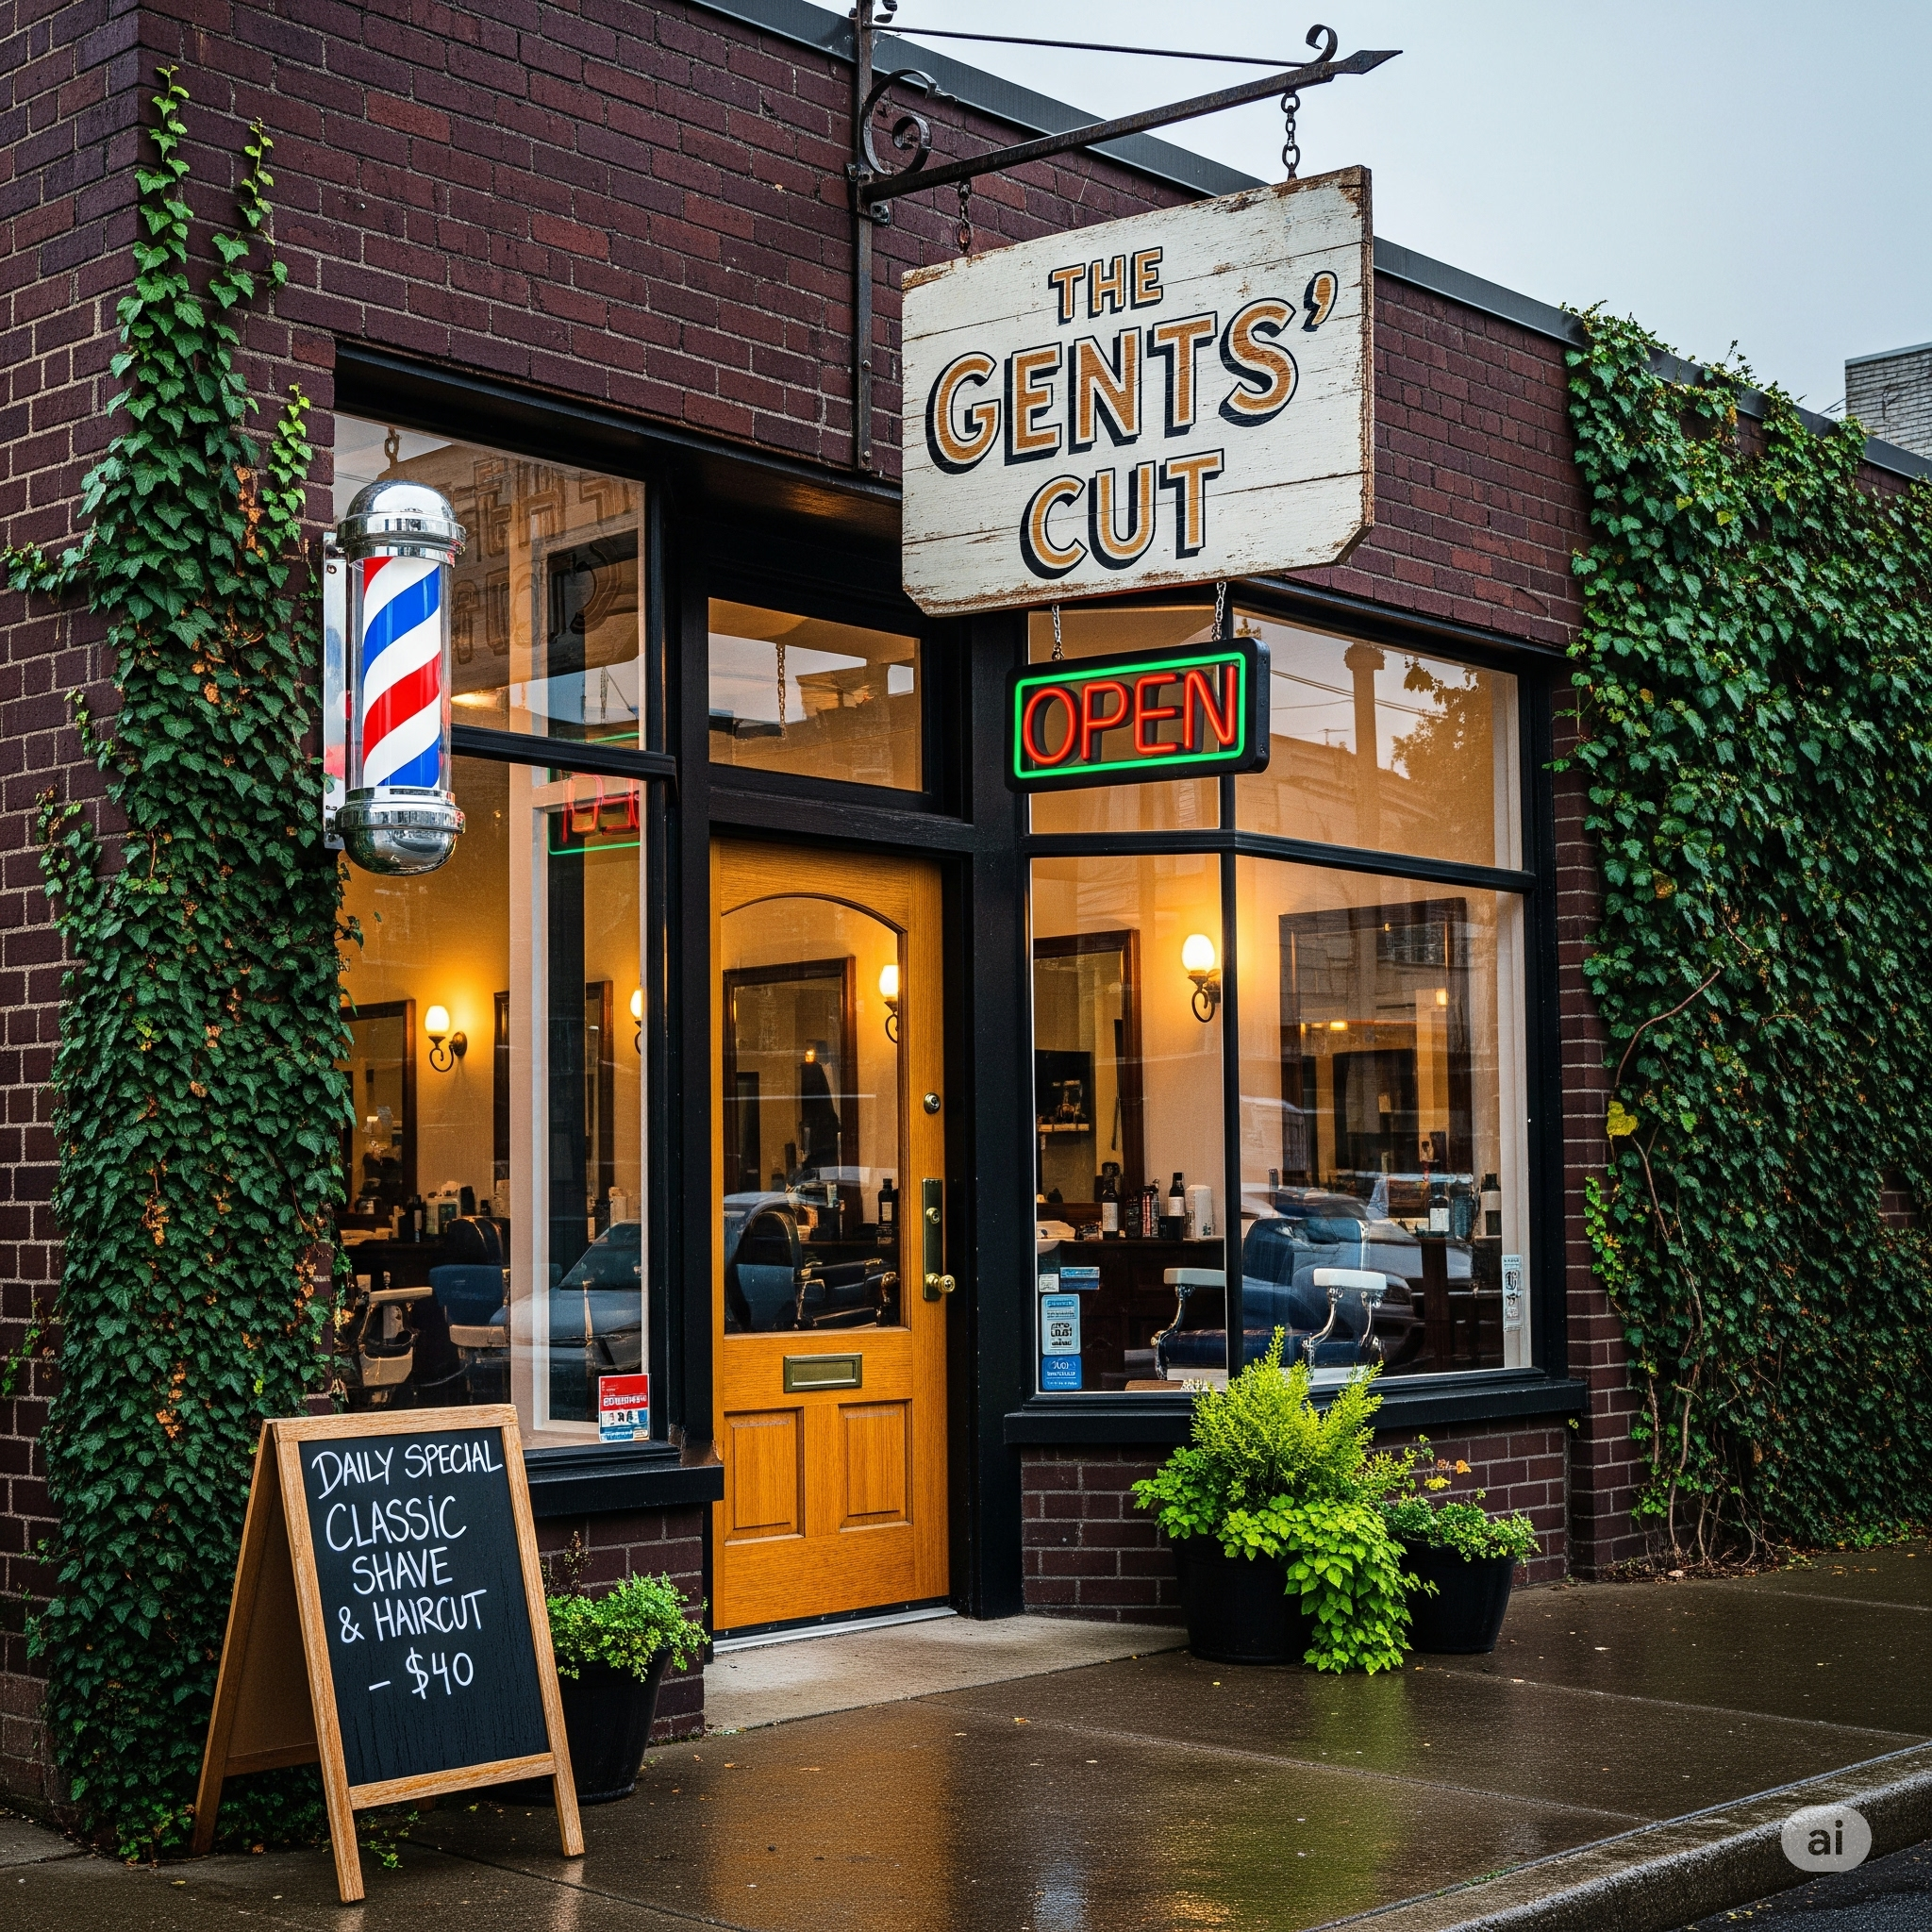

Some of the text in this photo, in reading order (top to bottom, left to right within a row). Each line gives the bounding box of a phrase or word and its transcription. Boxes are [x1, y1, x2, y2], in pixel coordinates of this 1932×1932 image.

[1047, 246, 1163, 325] THE
[925, 271, 1339, 475] GENTS'
[1020, 449, 1224, 579] CUT
[1023, 665, 1237, 765] OPEN
[311, 1440, 503, 1499] DAILY SPECIAL
[352, 1546, 453, 1594] SHAVE
[338, 1589, 487, 1643] & HAIRCUT
[405, 1647, 474, 1699] $40
